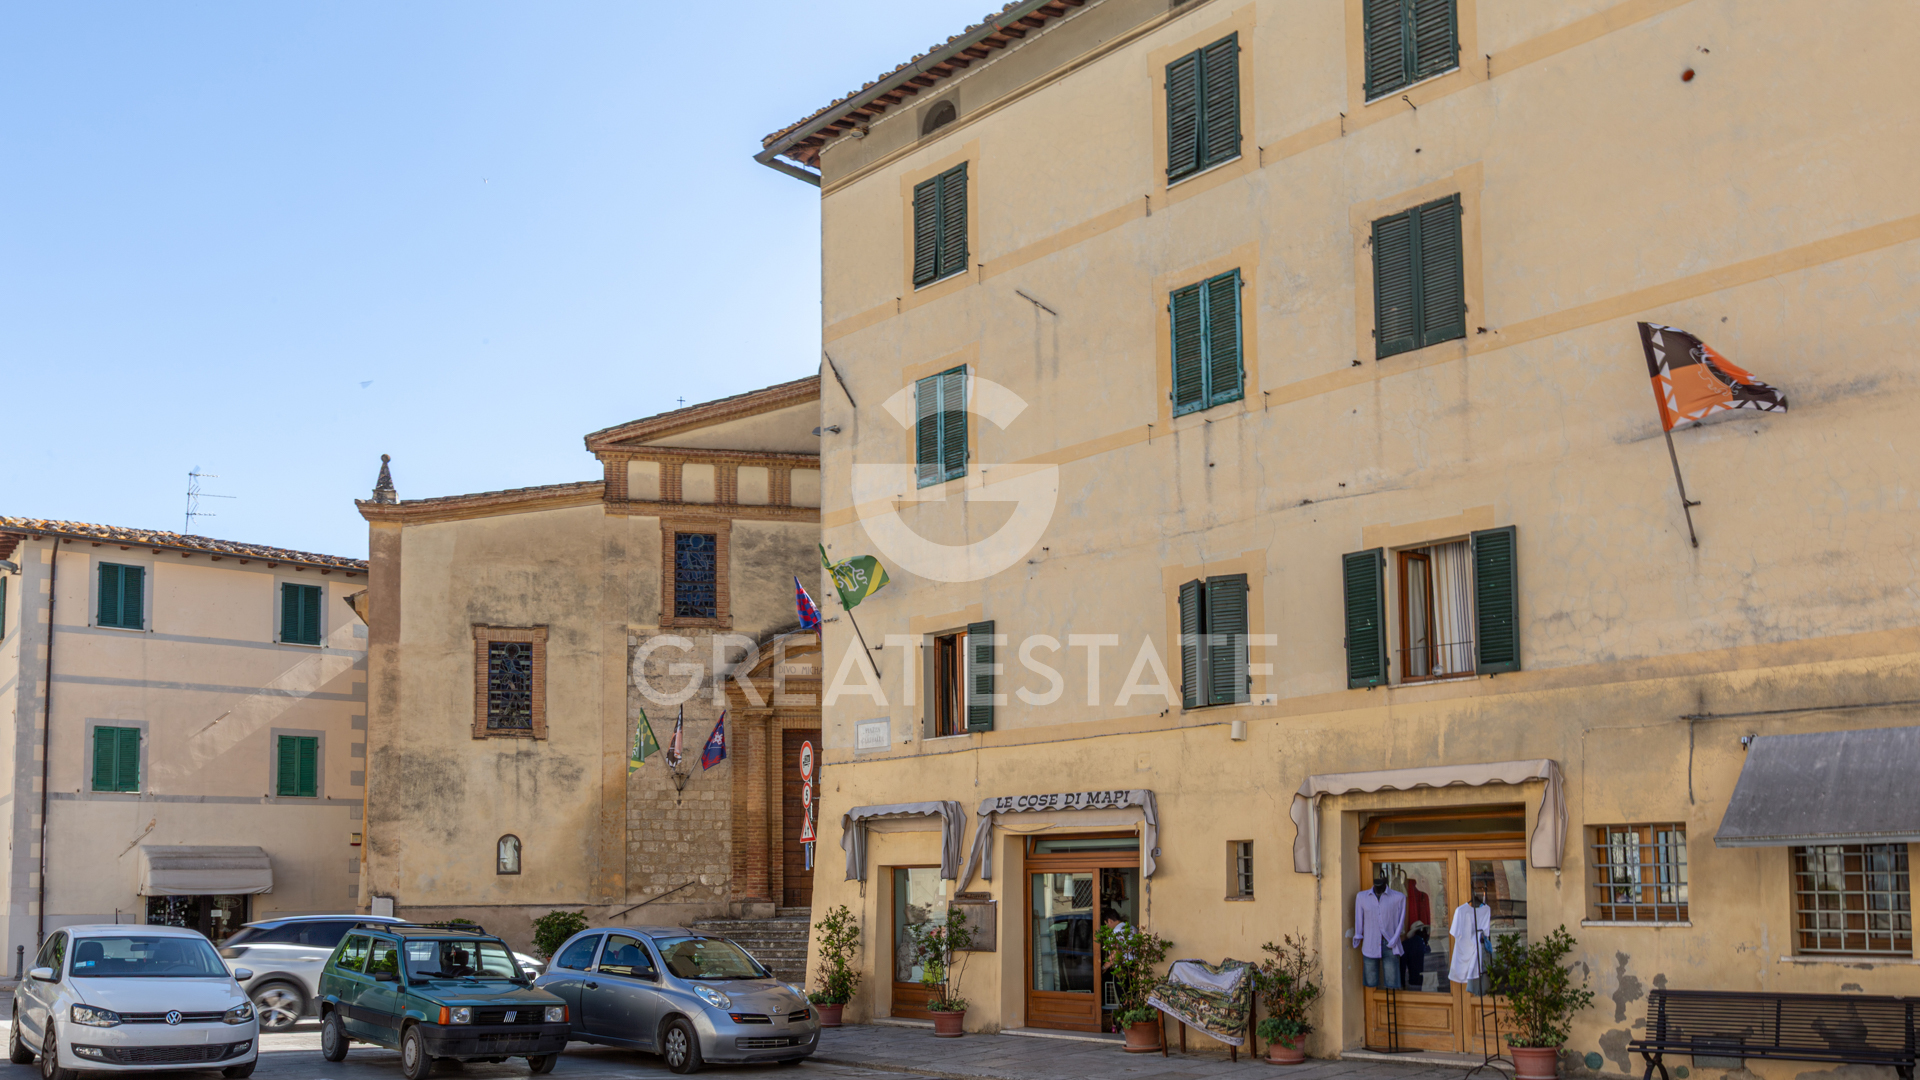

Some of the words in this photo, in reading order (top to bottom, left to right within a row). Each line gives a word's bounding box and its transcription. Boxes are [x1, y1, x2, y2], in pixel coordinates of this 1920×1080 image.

[778, 665, 797, 674] DIVO
[996, 796, 1013, 809] LE
[1017, 793, 1059, 808] COSE
[1064, 792, 1082, 805] DI
[1086, 790, 1131, 805] MAPI
